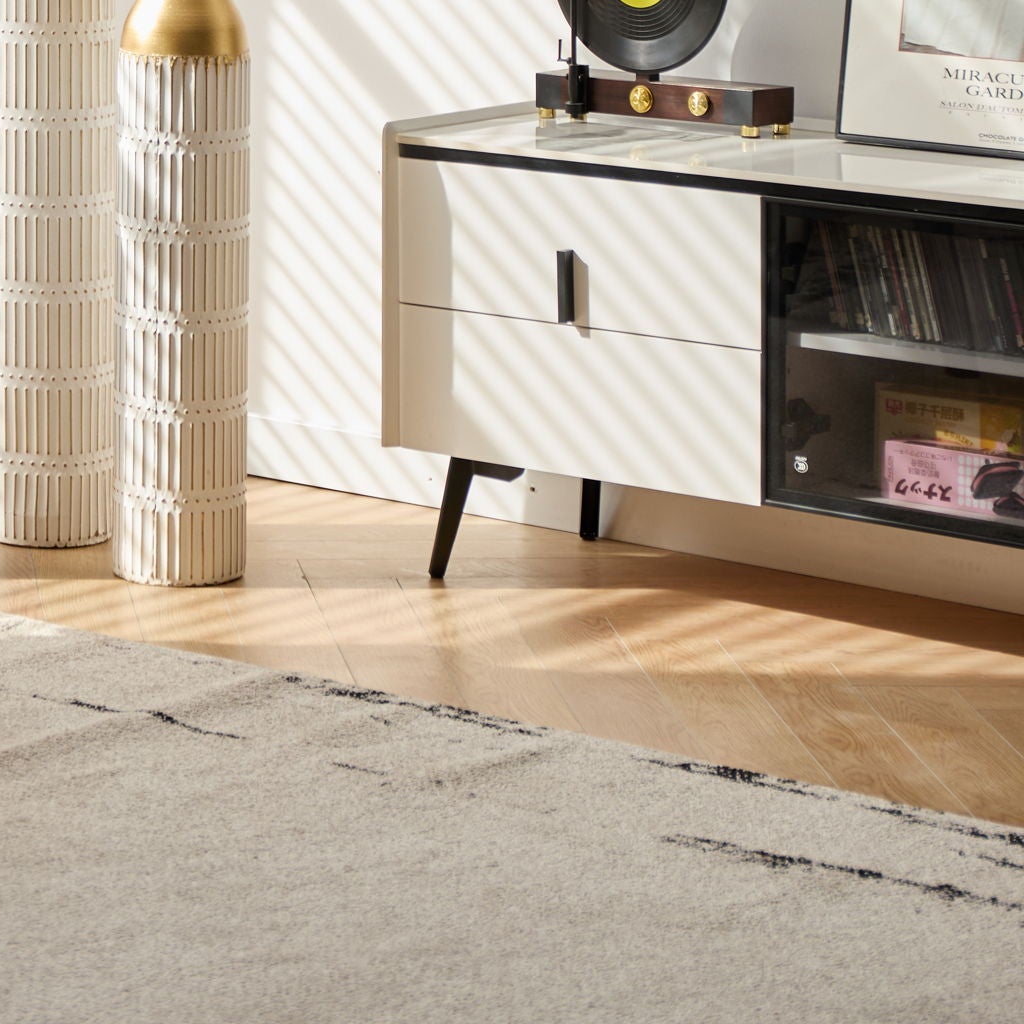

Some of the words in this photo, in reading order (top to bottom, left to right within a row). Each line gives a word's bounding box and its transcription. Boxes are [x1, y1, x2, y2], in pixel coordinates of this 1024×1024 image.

[943, 67, 1024, 85] MIRACU
[965, 84, 1024, 100] GARD
[978, 132, 1016, 141] CHOCOLATE
[895, 478, 952, 502] スナック
